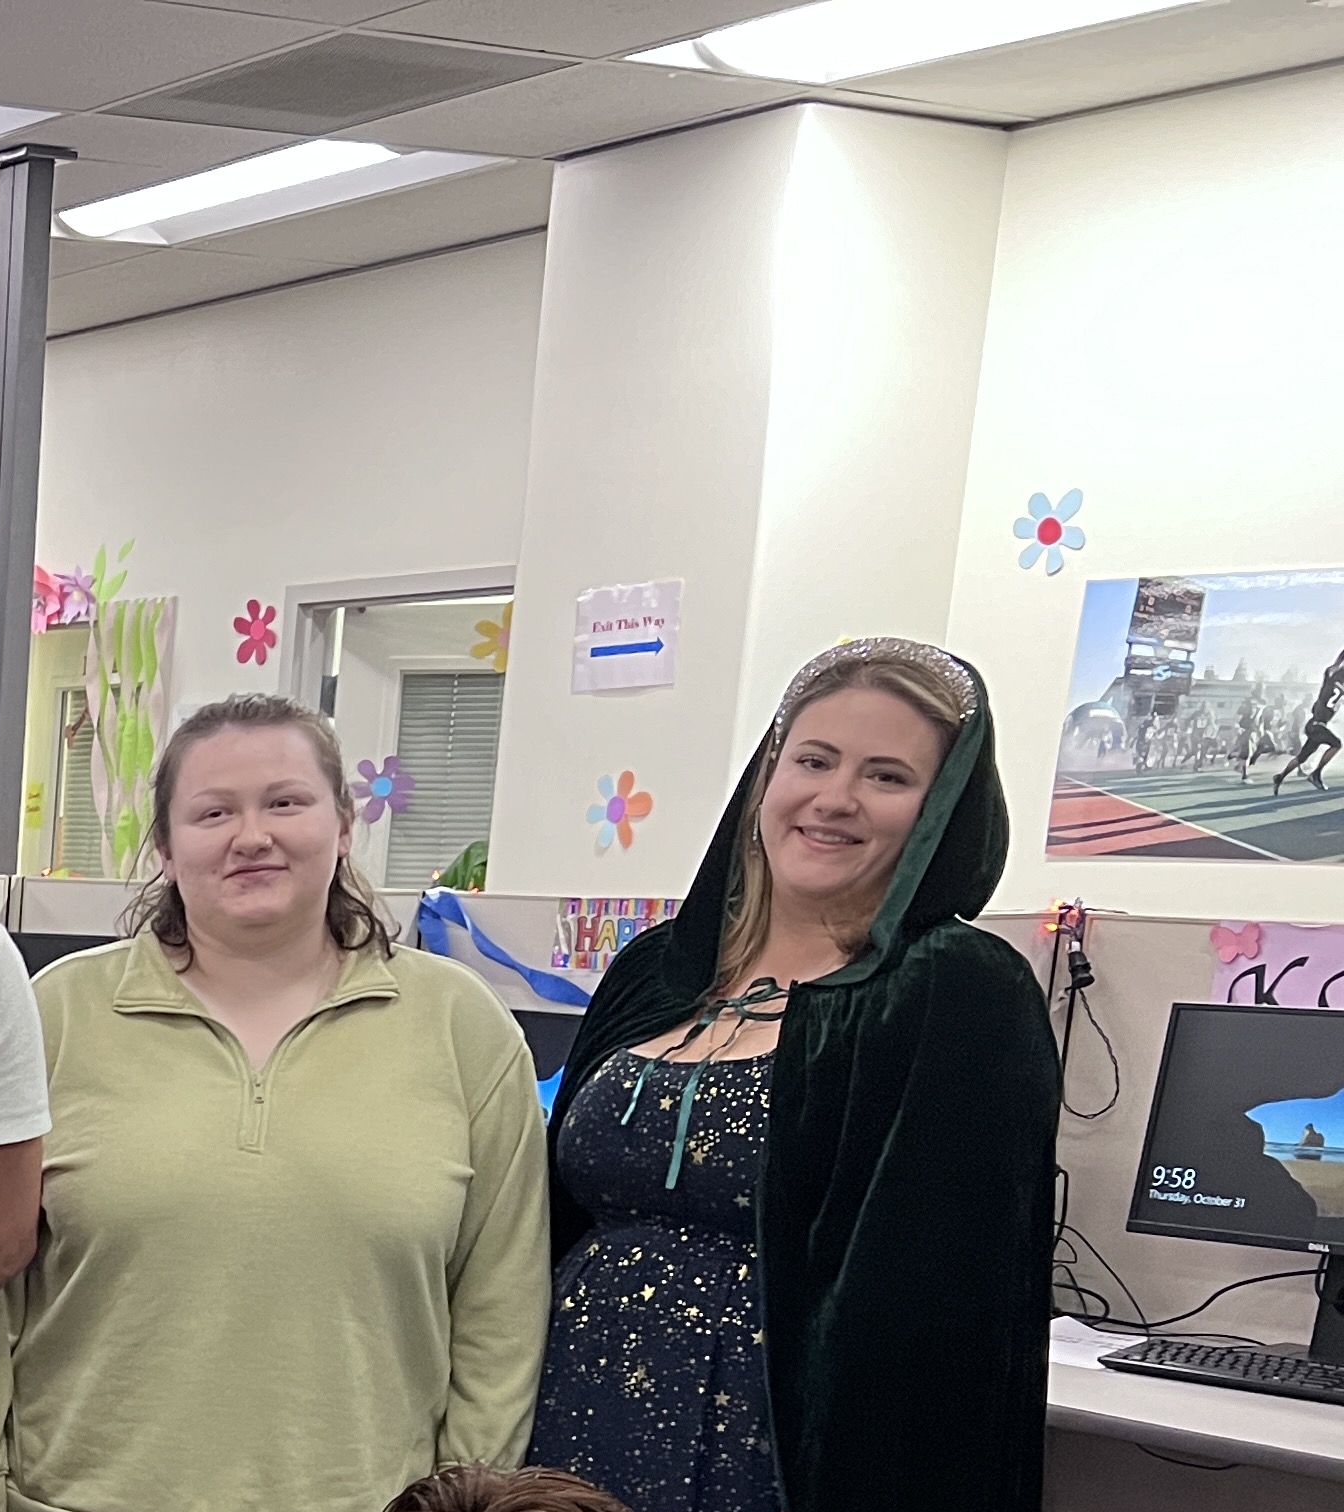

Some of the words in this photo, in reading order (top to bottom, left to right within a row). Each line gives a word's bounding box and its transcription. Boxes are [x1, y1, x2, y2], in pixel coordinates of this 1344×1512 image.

[592, 621, 613, 633] Exit
[616, 618, 639, 630] This
[643, 616, 665, 629] Way
[1152, 1166, 1196, 1190] 9:58
[1149, 1189, 1191, 1205] Thursday,
[1193, 1193, 1232, 1207] October
[1233, 1197, 1246, 1208] 31
